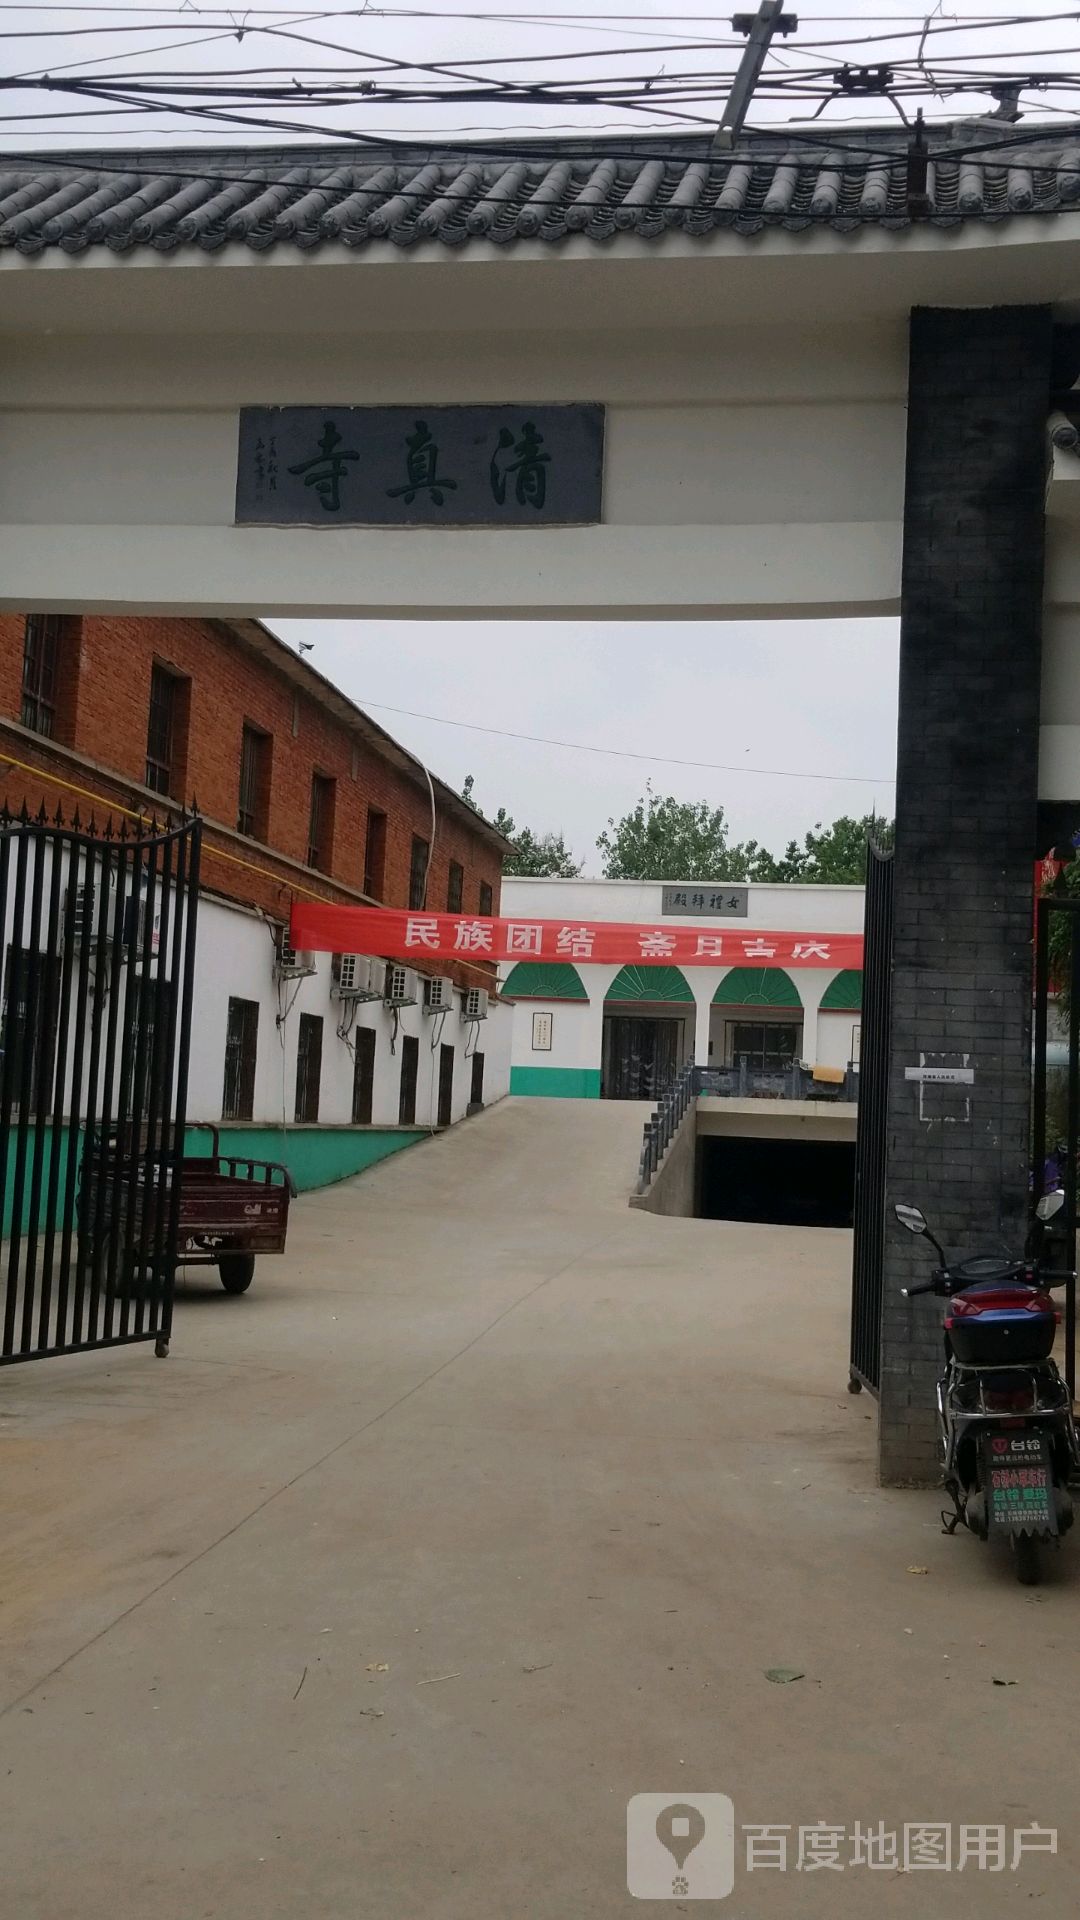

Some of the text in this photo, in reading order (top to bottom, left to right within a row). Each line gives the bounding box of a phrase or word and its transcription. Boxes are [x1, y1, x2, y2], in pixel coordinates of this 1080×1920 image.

[287, 420, 550, 511] 清真寺
[404, 917, 831, 960] 民族团结 斋月吉庆
